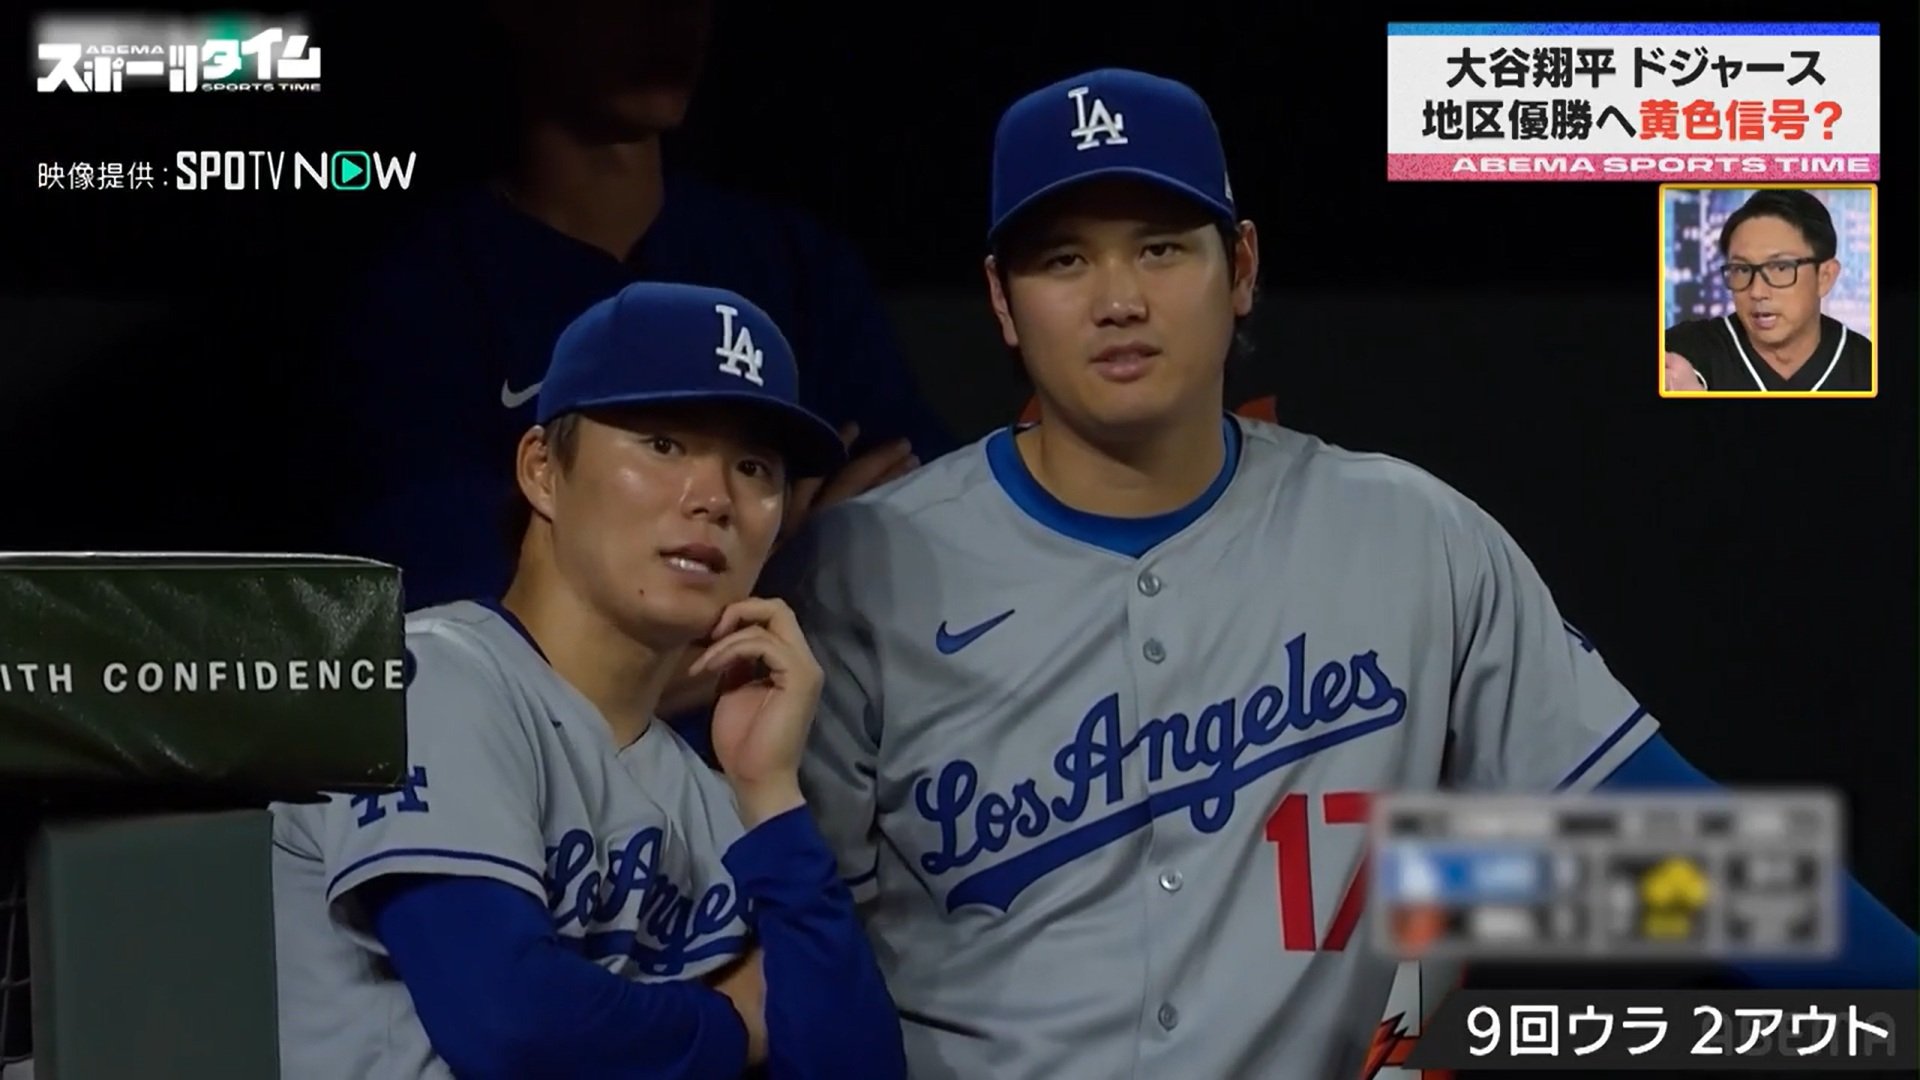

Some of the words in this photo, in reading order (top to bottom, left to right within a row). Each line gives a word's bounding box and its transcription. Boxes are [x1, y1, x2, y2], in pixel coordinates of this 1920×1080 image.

[1068, 86, 1128, 150] LA
[715, 304, 764, 387] LA
[103, 659, 403, 693] CONFIDENCE
[915, 759, 1050, 875] Los
[1051, 632, 1407, 834] Angeles
